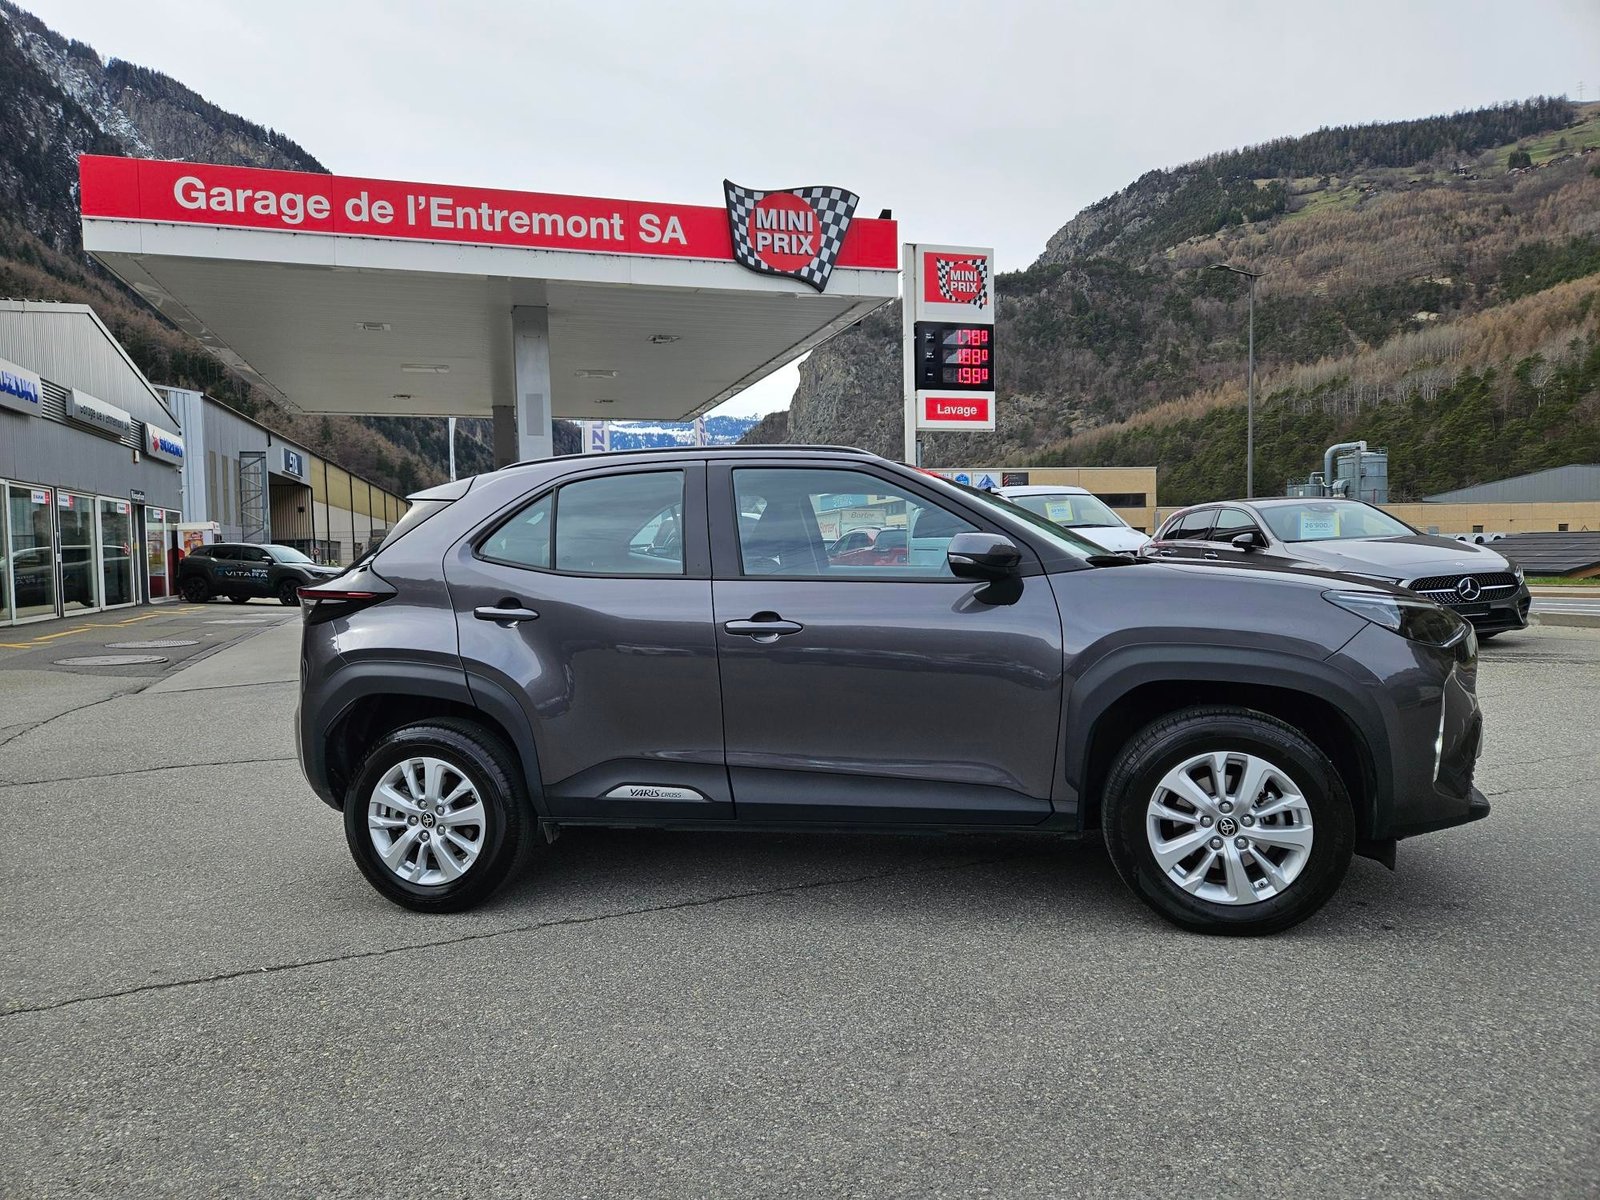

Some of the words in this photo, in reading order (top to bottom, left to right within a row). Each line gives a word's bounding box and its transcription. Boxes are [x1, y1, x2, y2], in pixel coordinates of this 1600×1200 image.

[173, 176, 331, 225] Garage
[344, 191, 394, 223] de
[406, 195, 625, 241] l'Entremont
[638, 213, 688, 245] SA
[755, 207, 813, 233] MINI
[755, 231, 814, 255] PRIX
[950, 269, 977, 282] MINI
[950, 281, 978, 293] PRIX
[937, 403, 977, 417] Lavage
[160, 438, 183, 458] SUZUKI
[225, 570, 268, 578] VITARA
